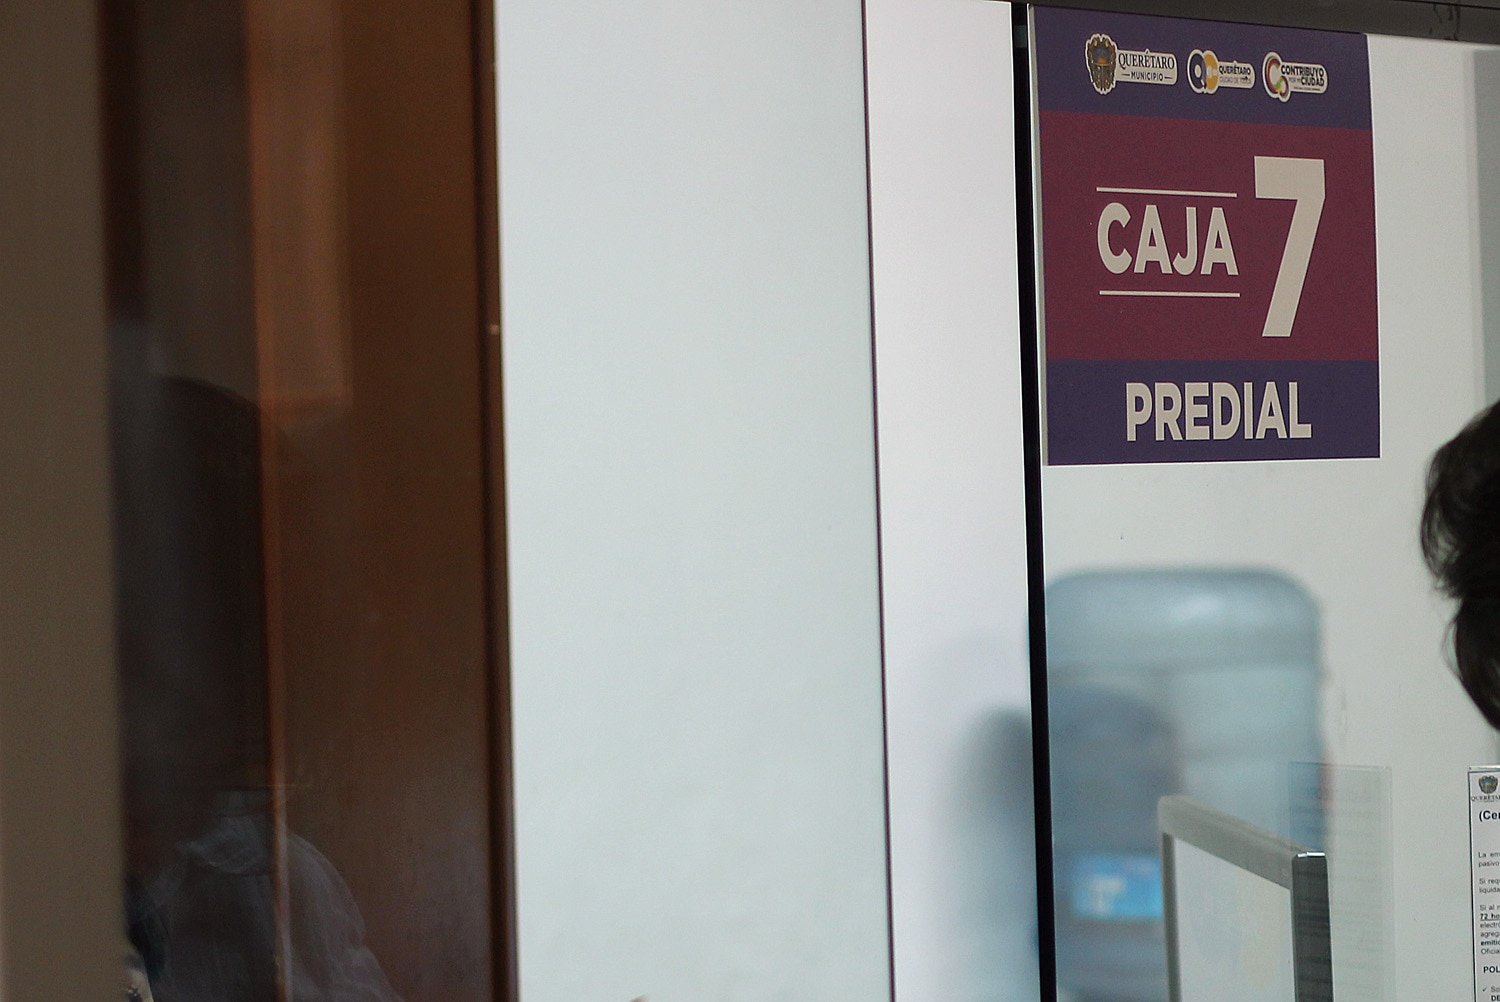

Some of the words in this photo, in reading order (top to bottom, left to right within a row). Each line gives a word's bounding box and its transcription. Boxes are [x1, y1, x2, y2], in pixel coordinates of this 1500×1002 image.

[1118, 50, 1174, 70] QUERÉTARO
[1218, 64, 1252, 76] QUERÉTARO
[1280, 64, 1324, 77] CONTRIBUYO
[1130, 72, 1164, 82] MUNICIPIO
[1302, 77, 1324, 86] CIUDAD
[1097, 202, 1239, 276] CAJA
[1254, 156, 1326, 337] 7
[1126, 381, 1312, 442] PREDIAL
[1479, 858, 1499, 868] pasivo
